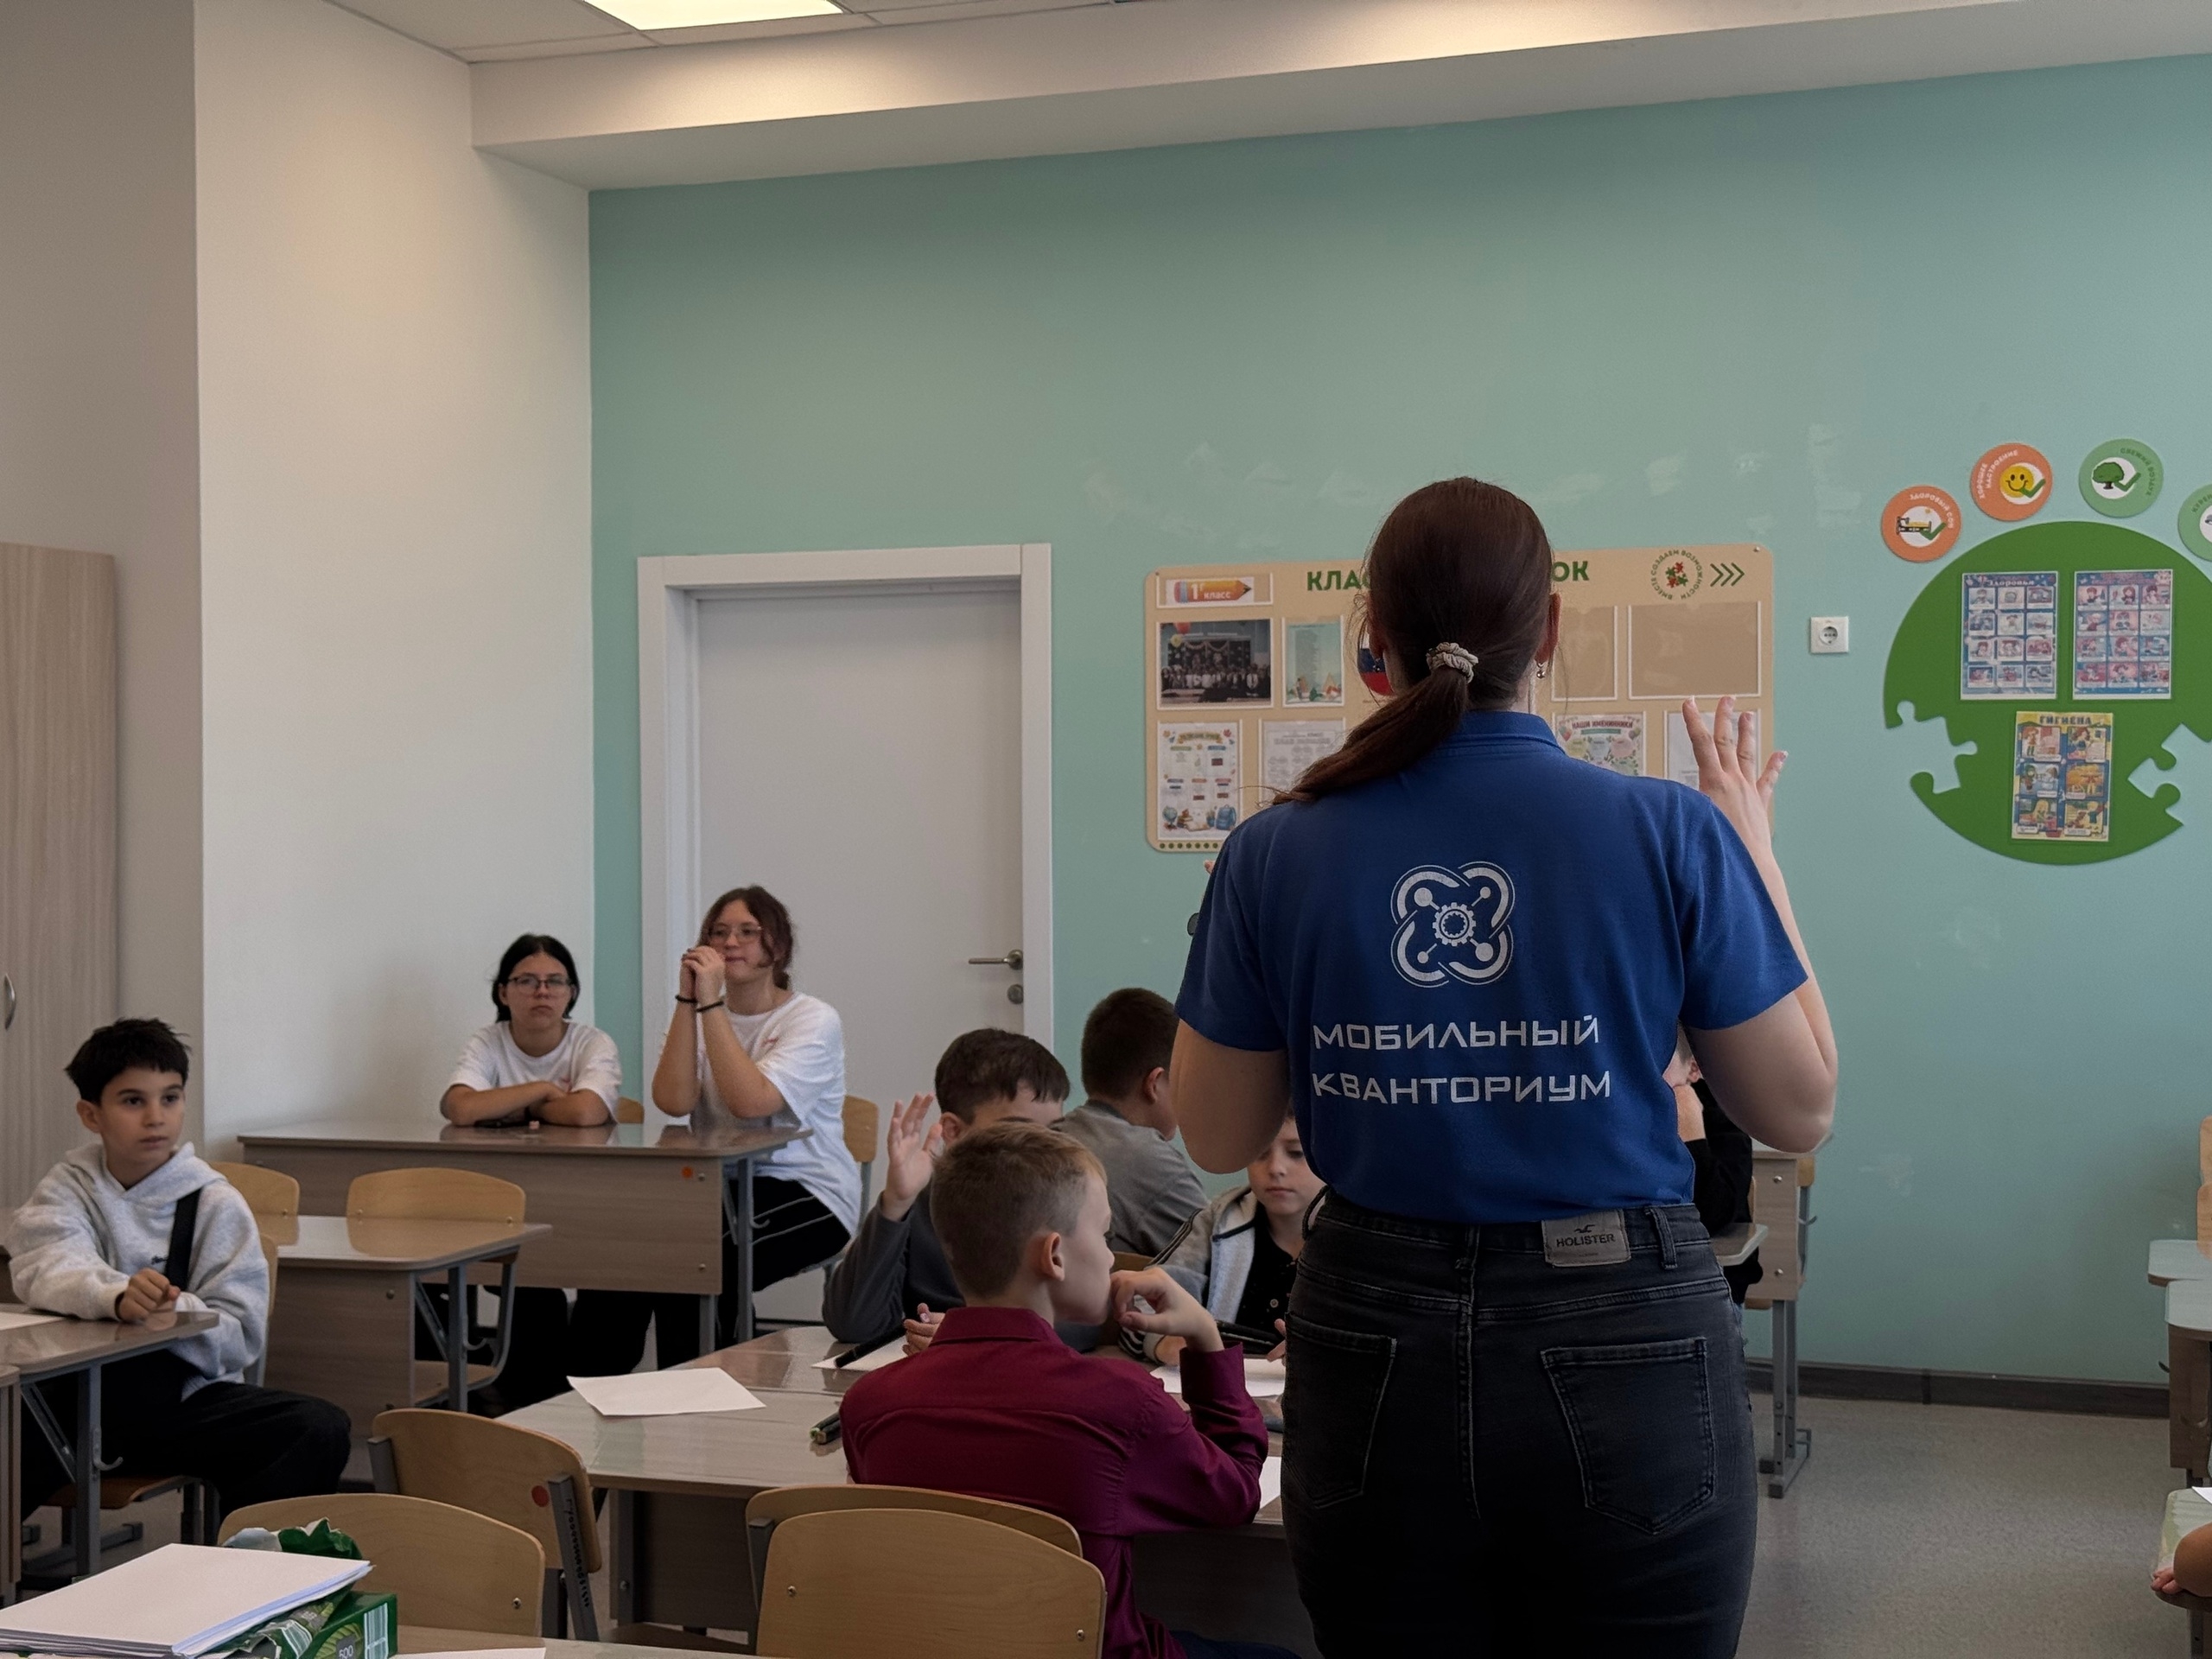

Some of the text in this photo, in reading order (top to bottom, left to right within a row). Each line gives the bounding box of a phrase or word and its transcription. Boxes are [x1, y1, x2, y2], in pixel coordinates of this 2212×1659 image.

[1910, 493, 1950, 512] ЗДОРОВЫЙ
[1550, 560, 1590, 582] ОК
[1650, 550, 1703, 600] ВМЕСТЕ СОЗДАЕМ ВОЗМОЖНОСТИ
[1313, 1014, 1599, 1051] МОБИЛЬНЫЙ
[1312, 1070, 1611, 1104] КВАНТОРИУМ
[1556, 1233, 1616, 1248] HOLISTER
